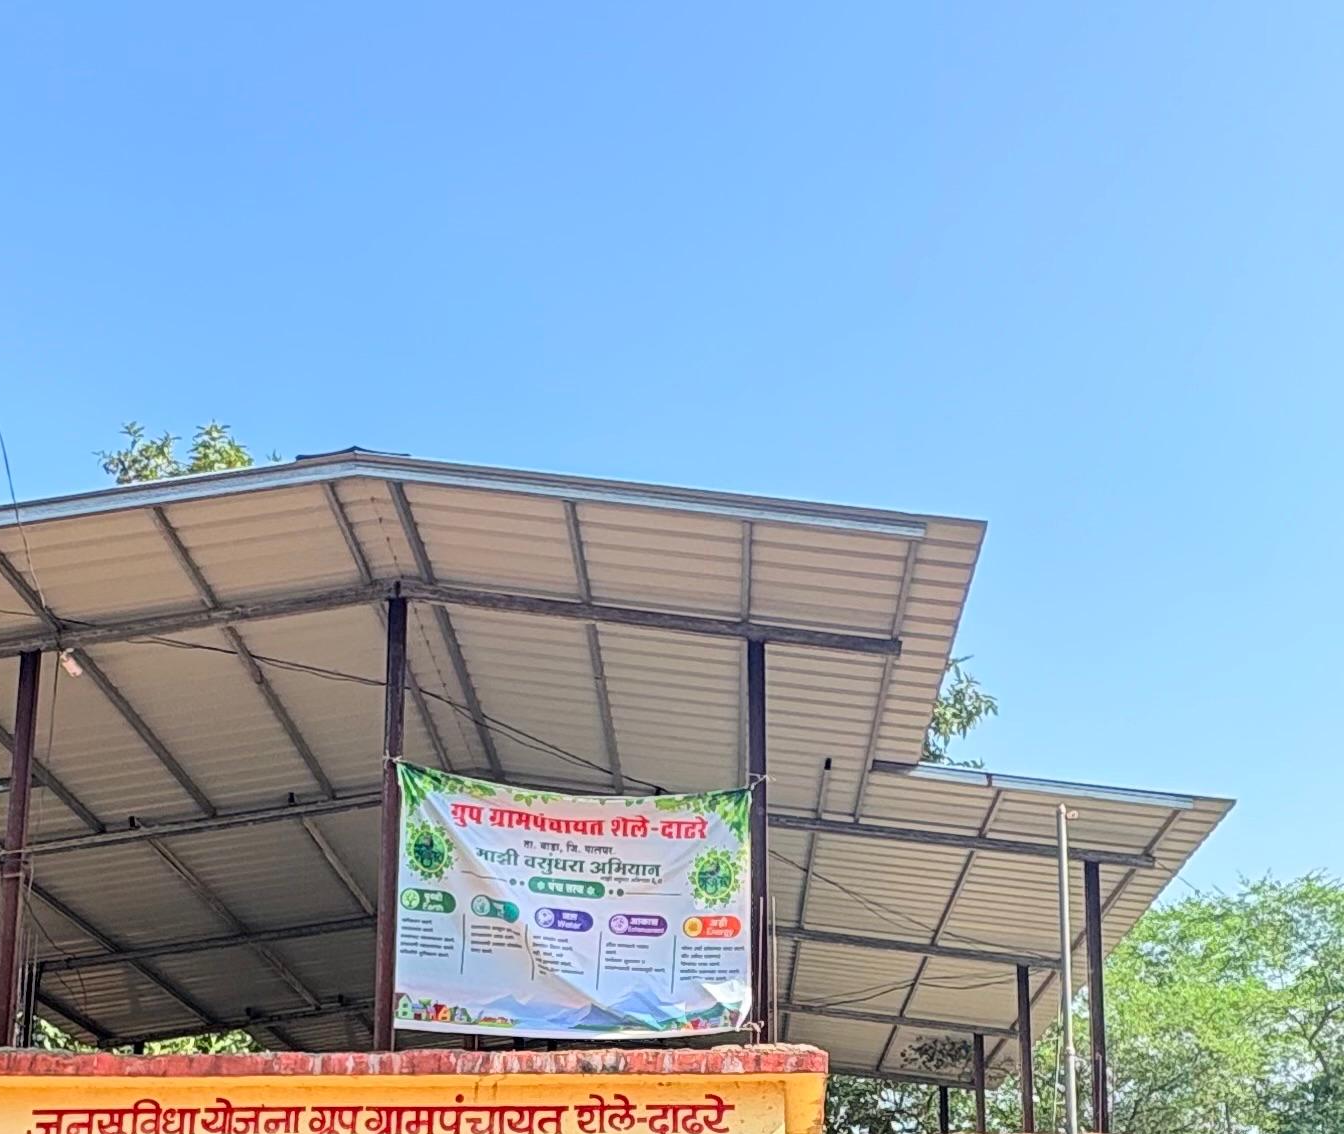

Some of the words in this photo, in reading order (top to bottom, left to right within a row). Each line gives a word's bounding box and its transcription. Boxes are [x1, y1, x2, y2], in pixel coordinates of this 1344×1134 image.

[451, 804, 483, 827] ग्रुप
[489, 808, 604, 836] ग्रामपंचायत
[476, 848, 519, 866] माझी
[524, 852, 585, 874] वसुंधरा
[590, 858, 662, 877] अभियान
